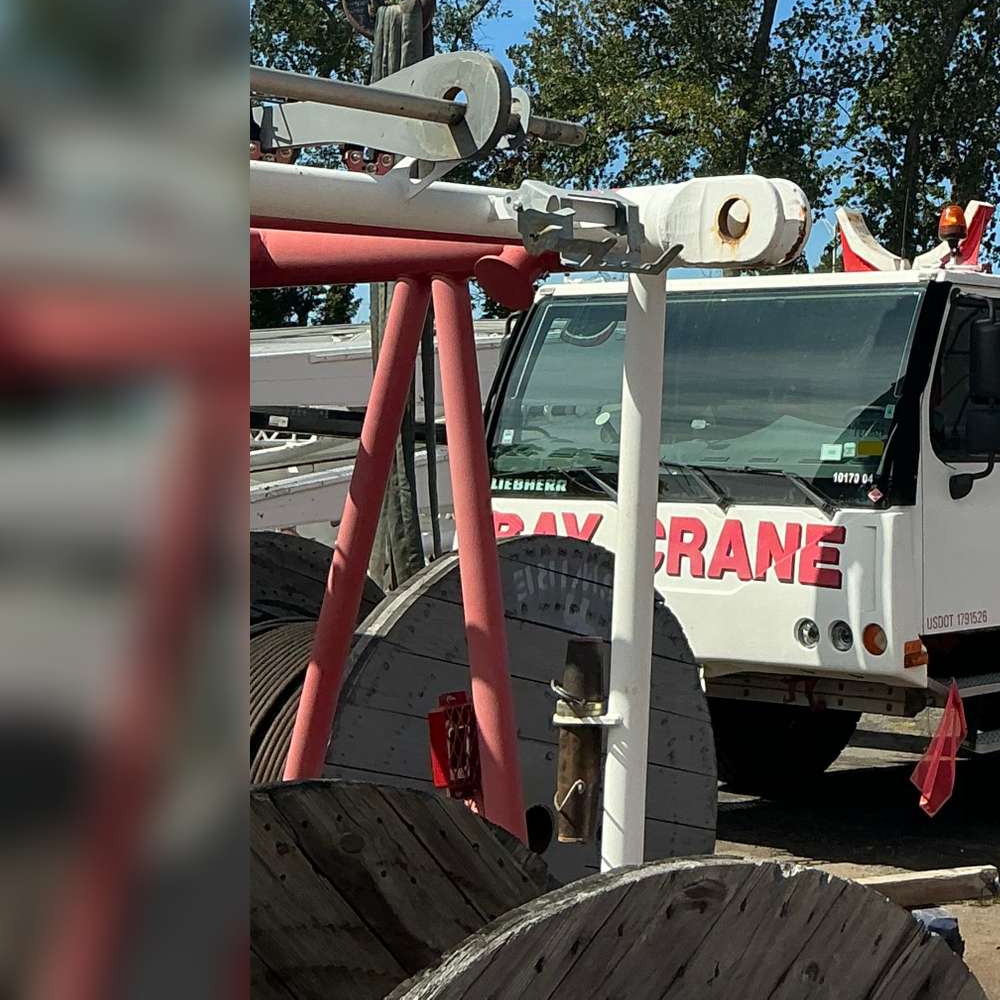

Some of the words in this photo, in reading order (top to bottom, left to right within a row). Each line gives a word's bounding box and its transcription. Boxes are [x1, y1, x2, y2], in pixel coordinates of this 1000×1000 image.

[490, 478, 567, 492] LIEBHERR
[926, 614, 954, 630] USDOT
[957, 610, 988, 626] 1791526
